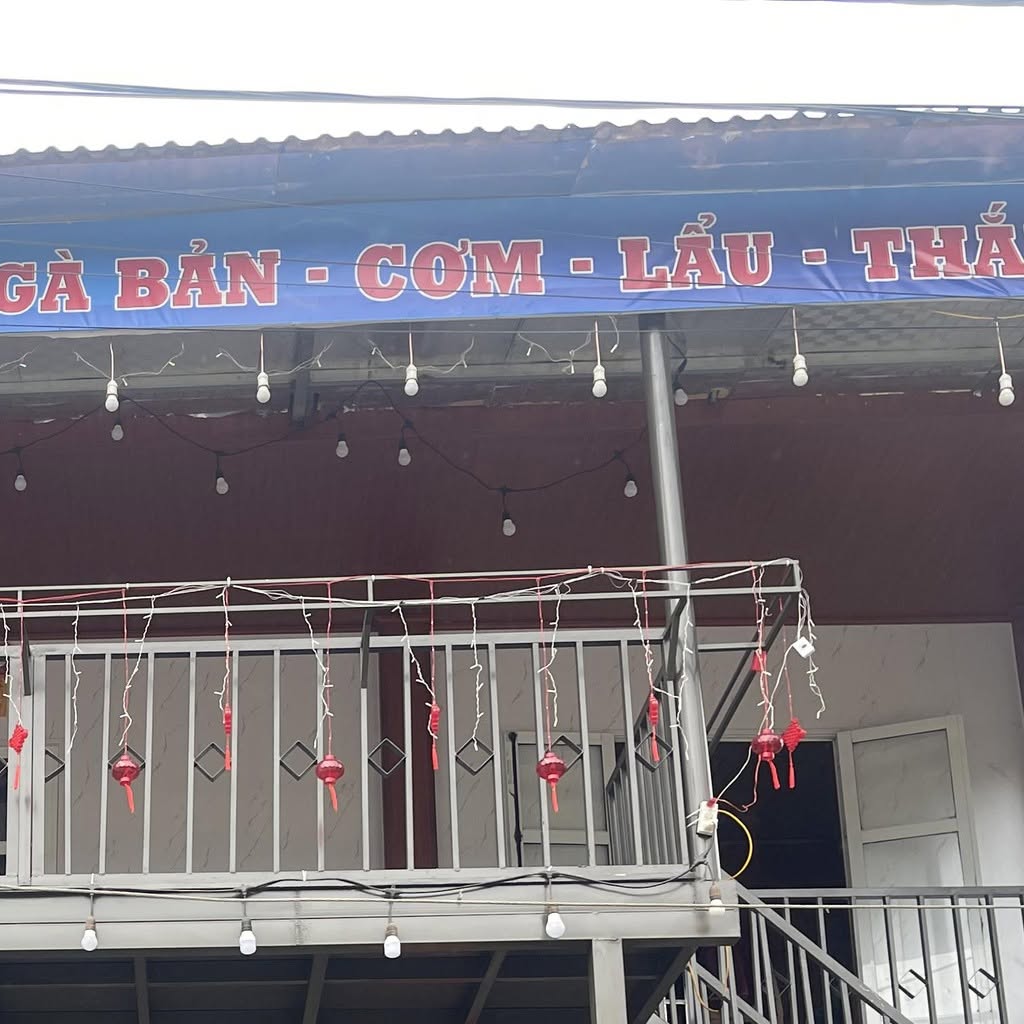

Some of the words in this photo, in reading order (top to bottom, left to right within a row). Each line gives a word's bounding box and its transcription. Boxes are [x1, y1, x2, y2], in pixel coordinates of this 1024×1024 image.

[114, 238, 281, 310] BẢN
[355, 238, 545, 301] CƠM
[618, 211, 773, 293] LẨU
